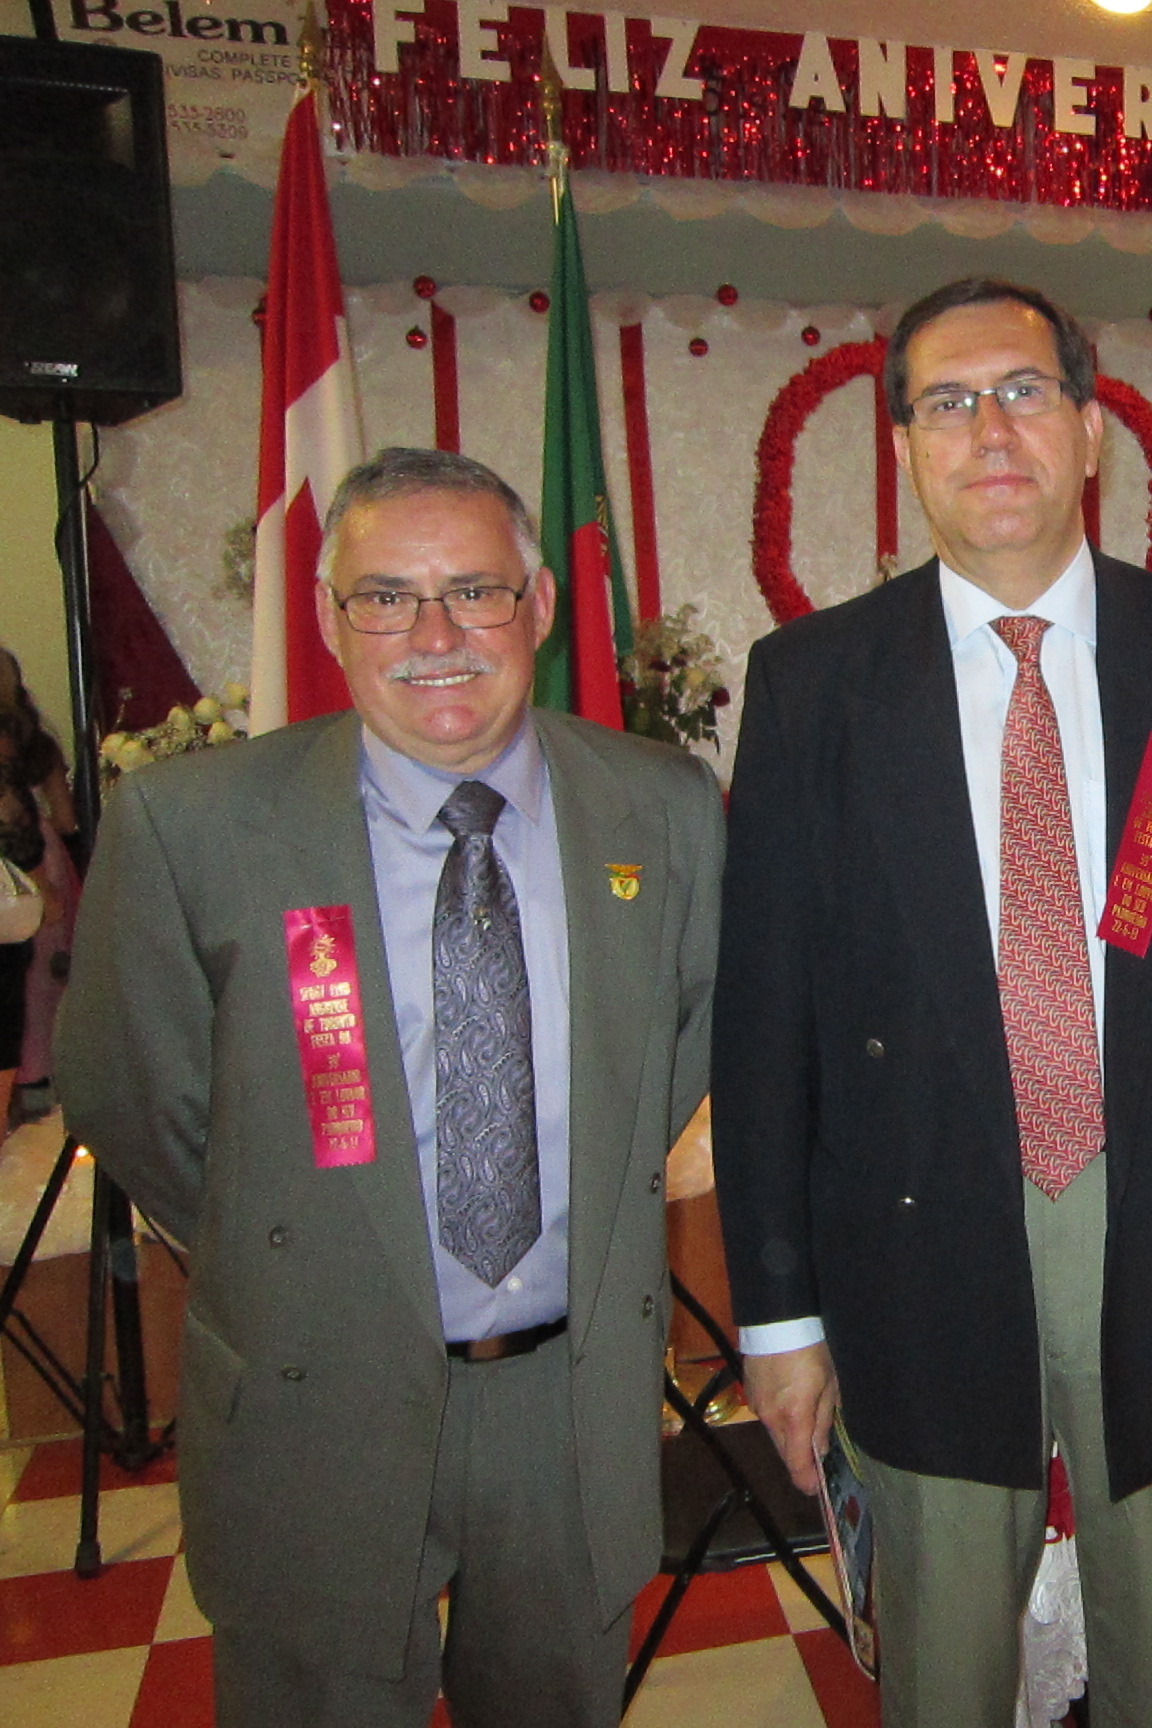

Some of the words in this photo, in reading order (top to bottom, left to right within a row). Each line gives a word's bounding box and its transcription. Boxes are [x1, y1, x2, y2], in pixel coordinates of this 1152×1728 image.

[71, 0, 289, 45] Belem
[197, 49, 291, 68] COMPLETE
[374, 0, 702, 99] FELIZ
[232, 69, 300, 85] PASSPO
